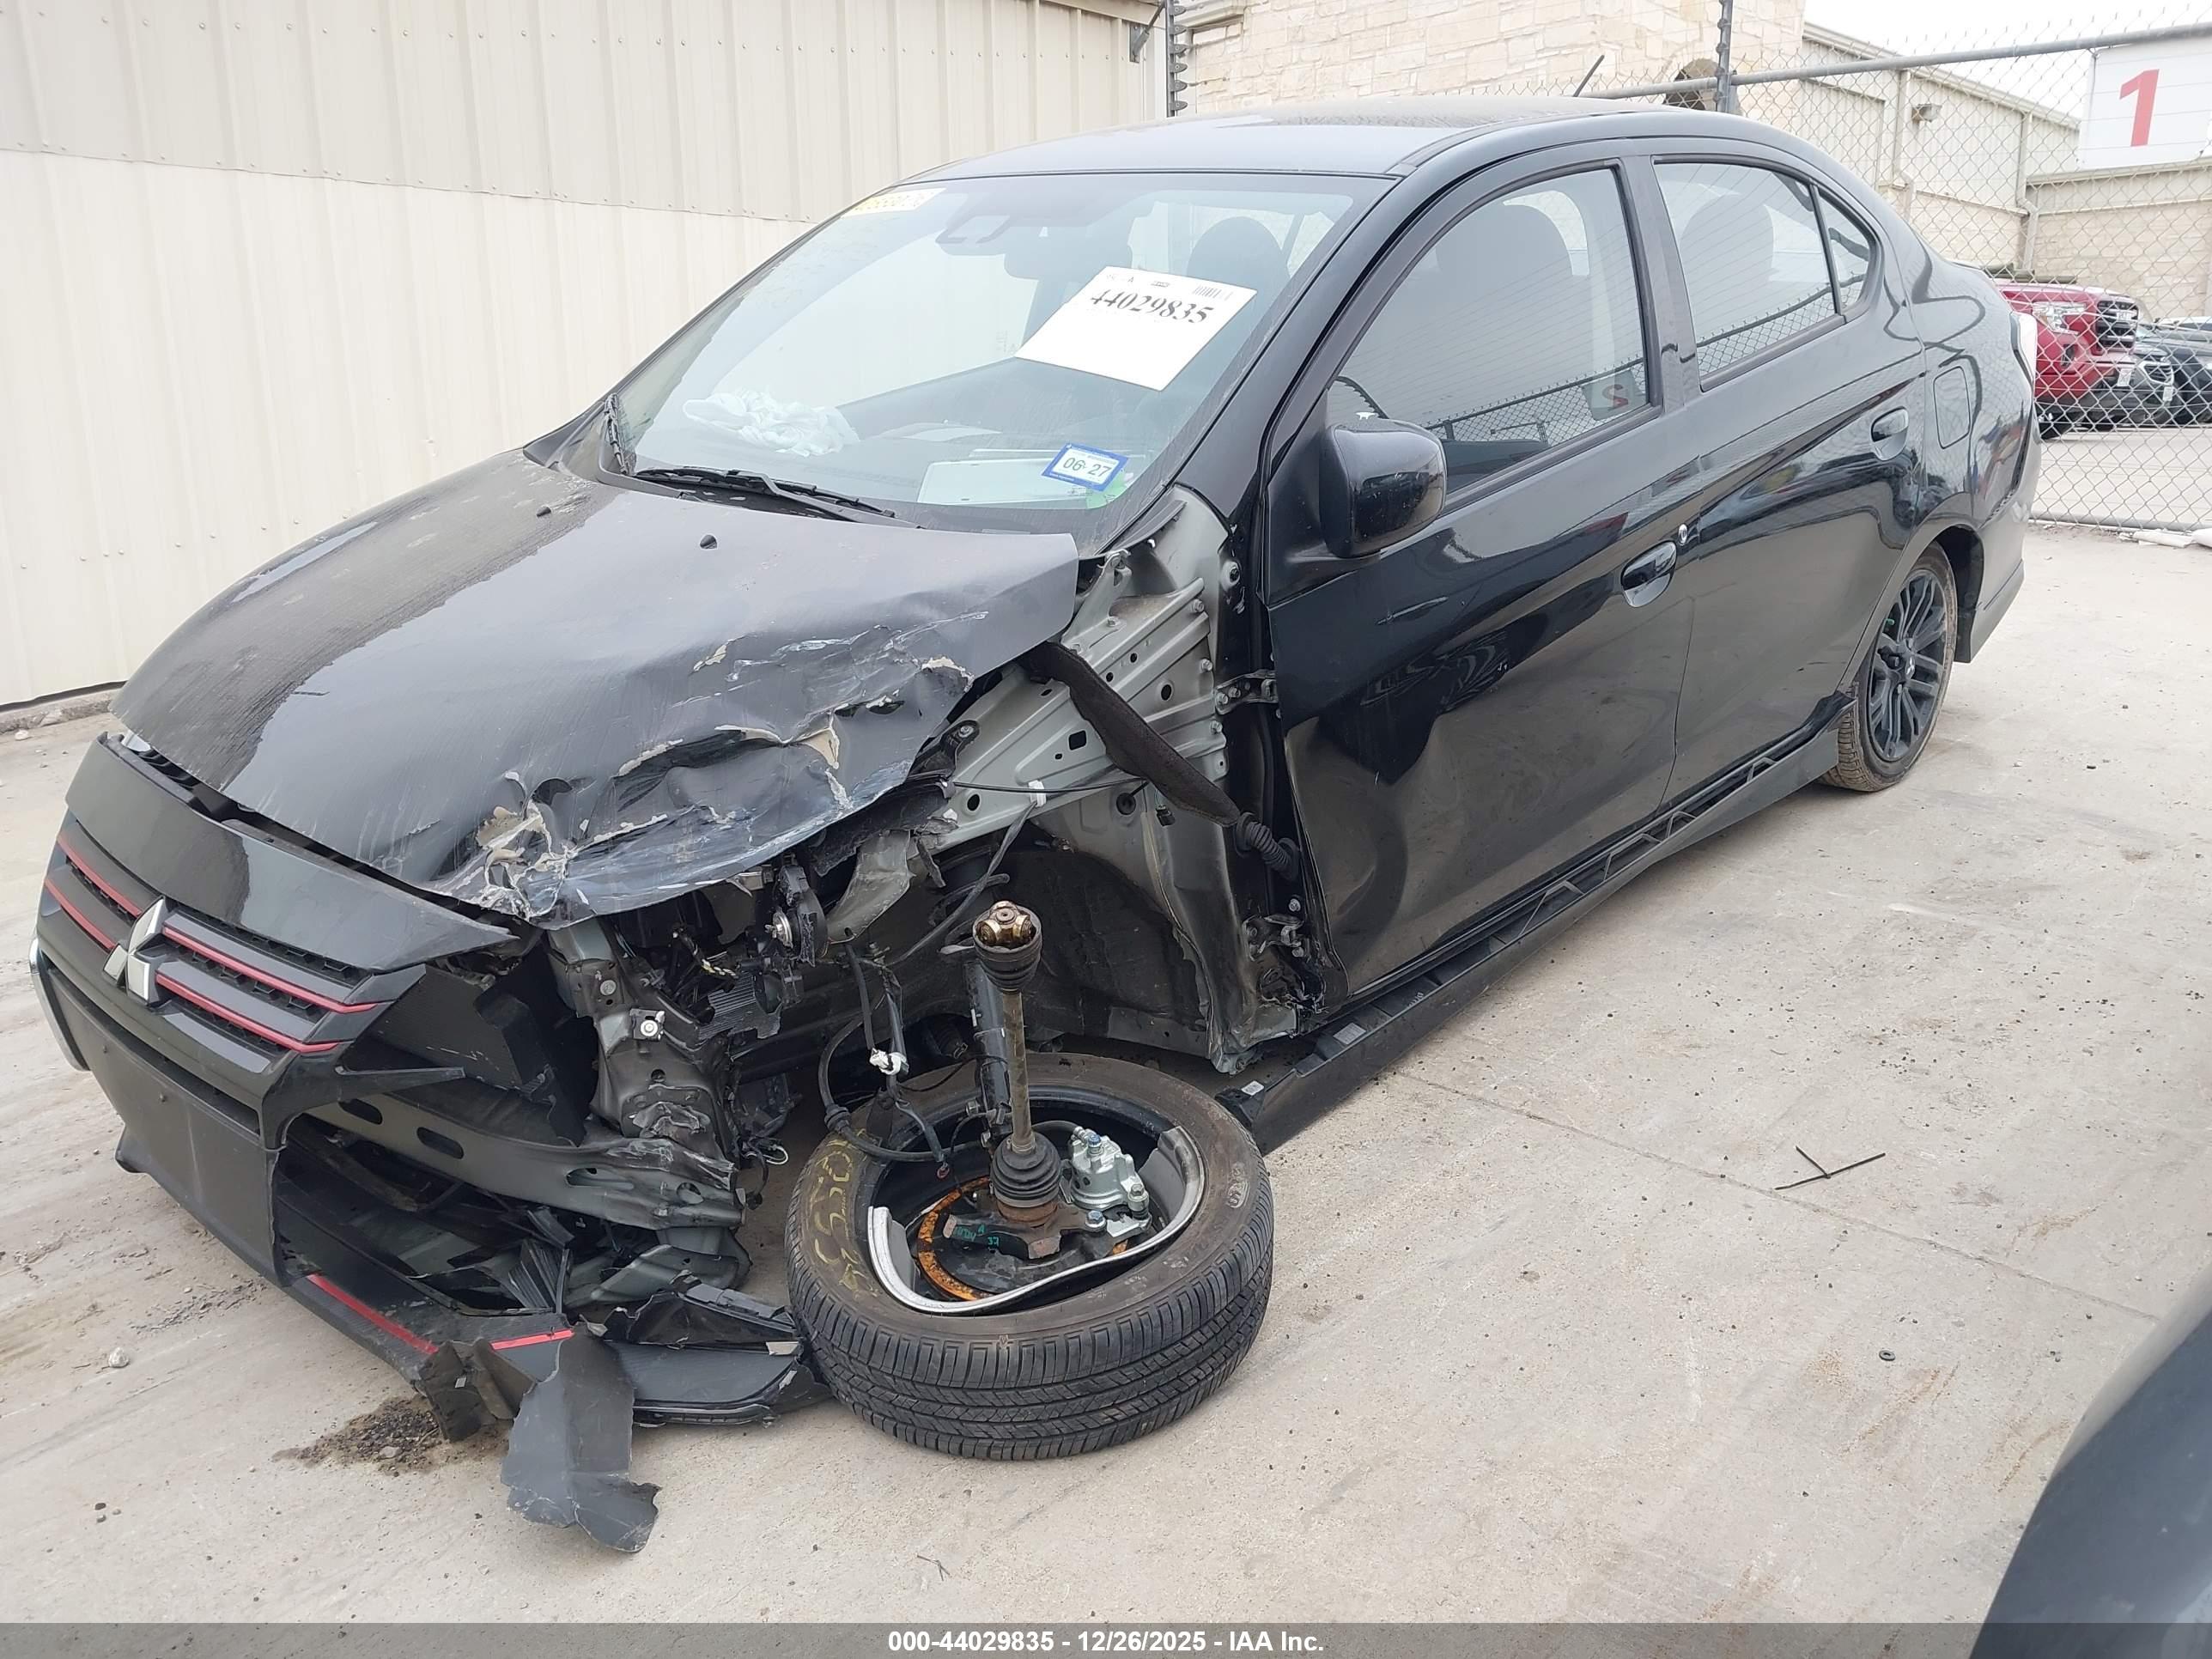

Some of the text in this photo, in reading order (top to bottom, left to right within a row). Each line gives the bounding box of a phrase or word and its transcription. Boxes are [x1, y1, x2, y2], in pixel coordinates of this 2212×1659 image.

[2120, 70, 2159, 147] 1
[1091, 289, 1215, 324] 44029835
[1087, 464, 1112, 477] 27
